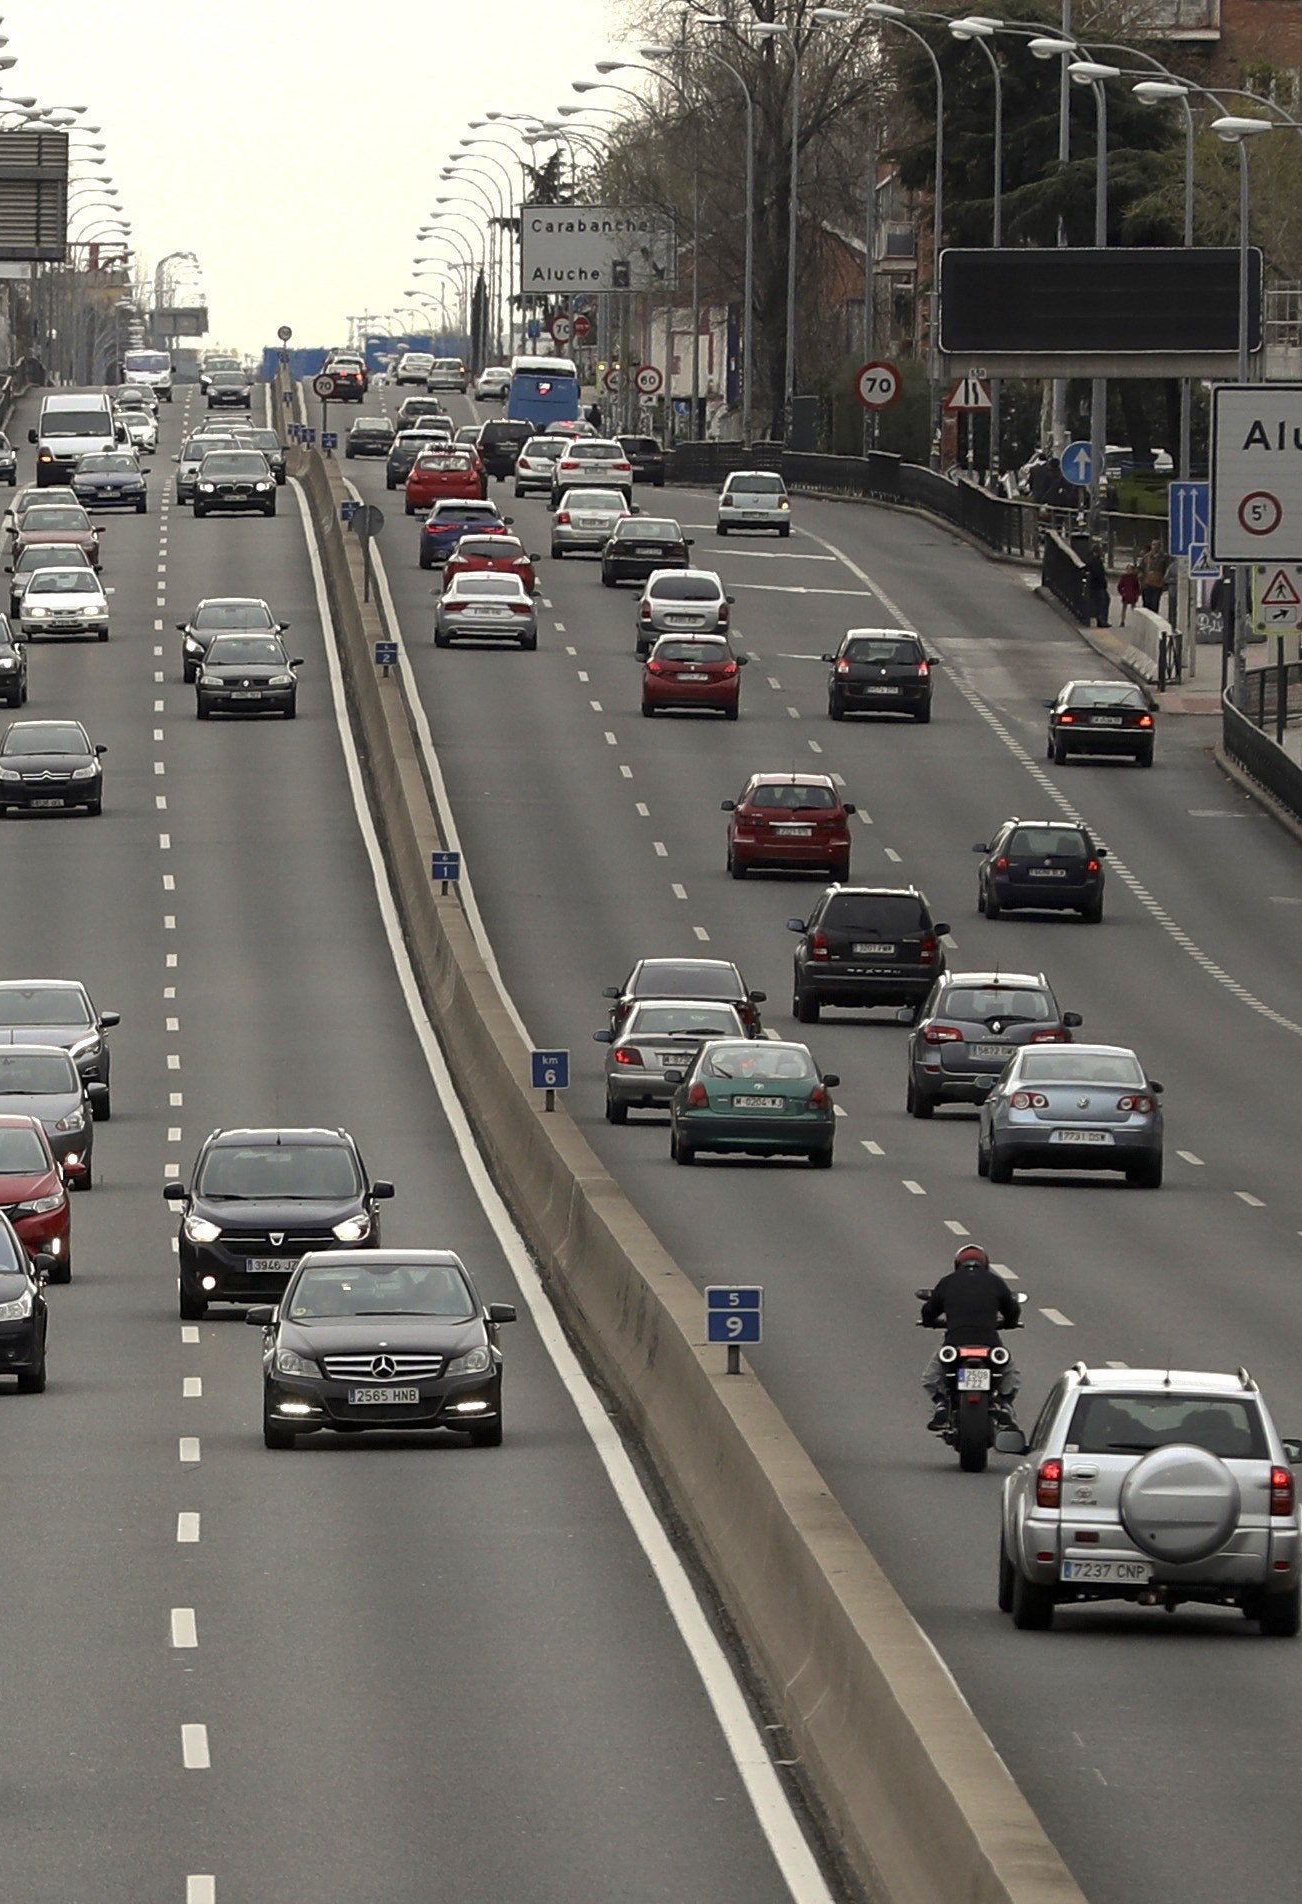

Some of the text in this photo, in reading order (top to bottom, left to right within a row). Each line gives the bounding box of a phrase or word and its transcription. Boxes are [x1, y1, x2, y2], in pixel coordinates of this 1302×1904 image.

[532, 266, 601, 281] Aluche
[318, 381, 332, 391] 70
[640, 375, 656, 386] 60
[865, 375, 892, 394] 70
[382, 653, 391, 663] 2
[443, 865, 448, 878] 1
[542, 1055, 559, 1065] km
[544, 1068, 557, 1085] 6
[255, 1260, 281, 1271] 3946
[729, 1292, 740, 1306] 5
[726, 1316, 744, 1338] 9
[357, 1389, 417, 1402] 2565 HNB
[1073, 1563, 1145, 1580] 7237 CNP
